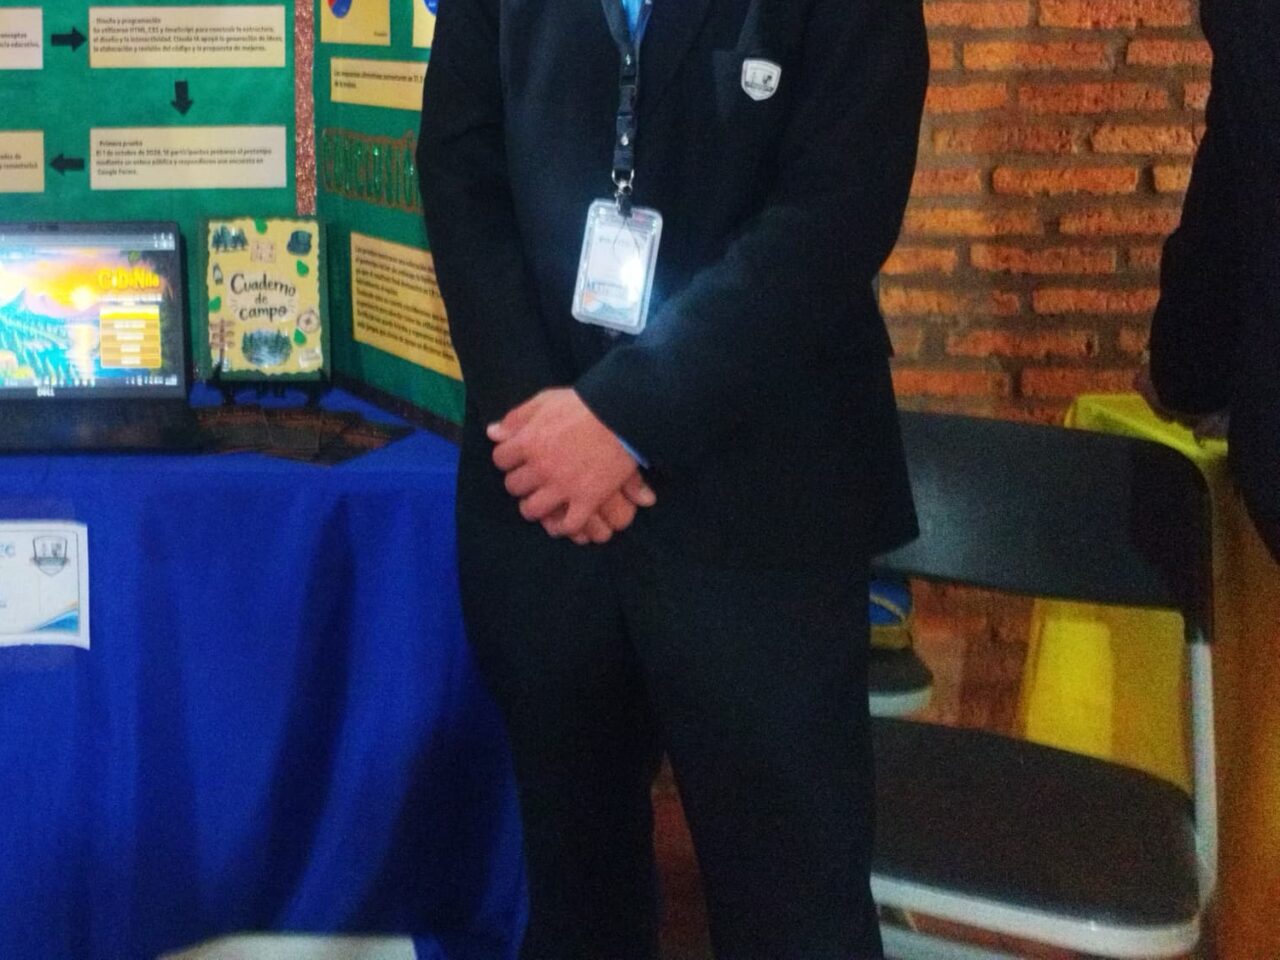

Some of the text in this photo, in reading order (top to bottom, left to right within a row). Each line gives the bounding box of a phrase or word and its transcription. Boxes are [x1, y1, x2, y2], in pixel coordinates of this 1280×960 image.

[230, 272, 296, 297] Cuaderno
[255, 292, 266, 305] de
[239, 305, 288, 323] campo
